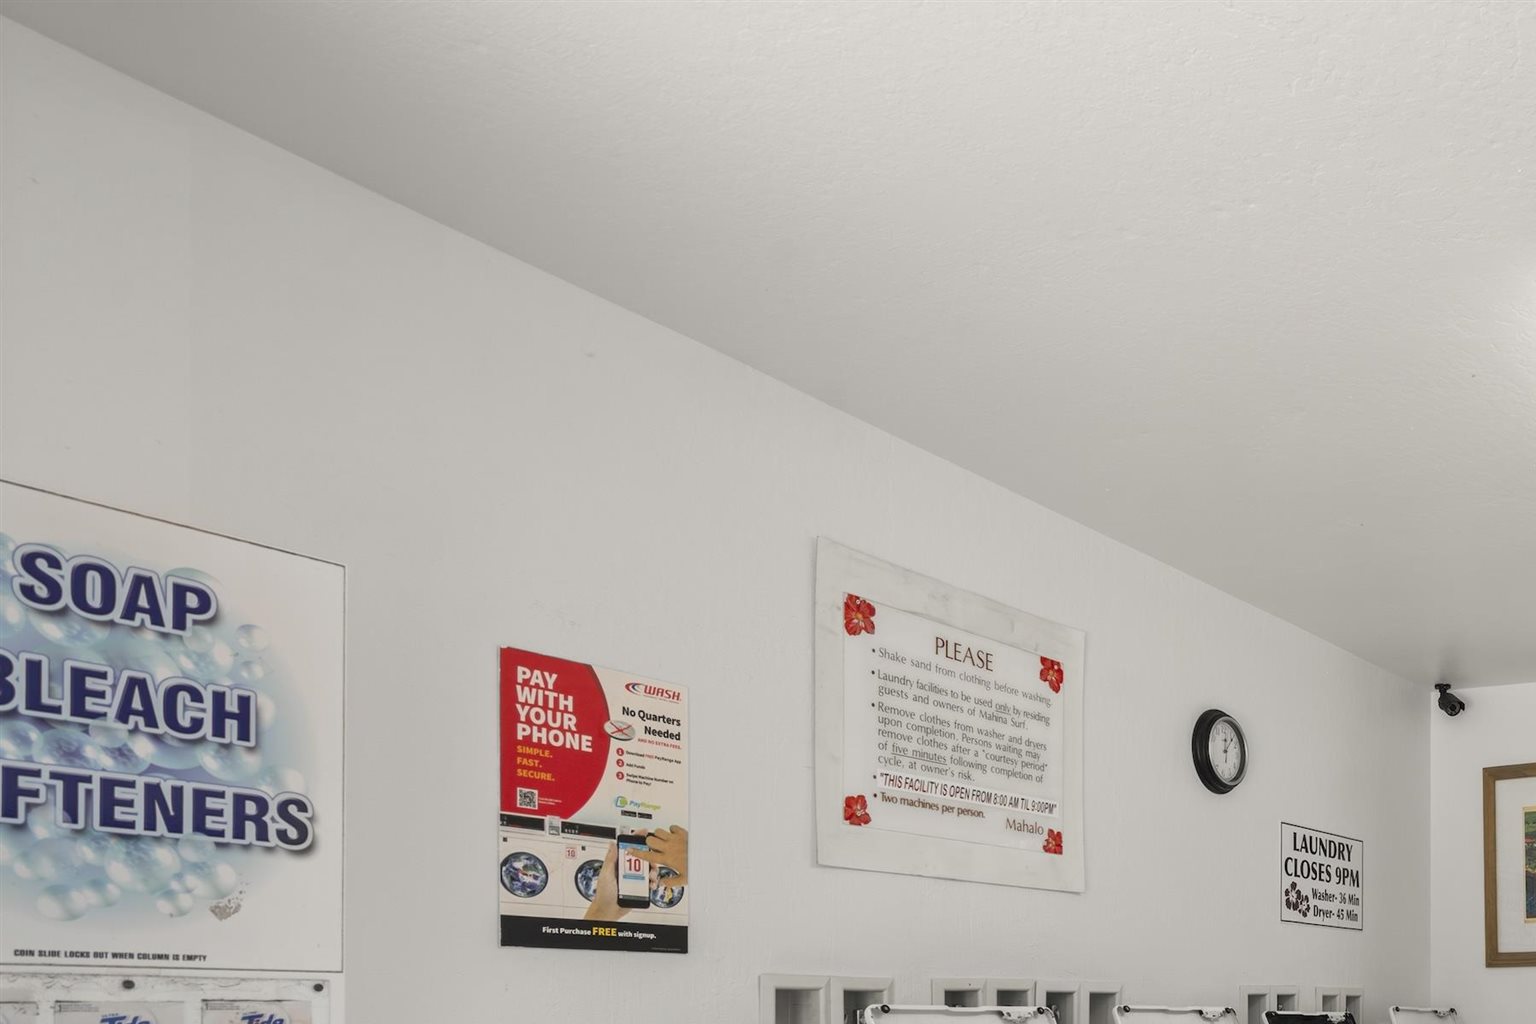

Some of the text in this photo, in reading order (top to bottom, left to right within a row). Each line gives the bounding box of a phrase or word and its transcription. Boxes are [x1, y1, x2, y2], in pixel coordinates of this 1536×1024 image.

[18, 548, 214, 633] SOAP
[936, 637, 993, 672] PLEASE
[517, 666, 558, 689] PAY
[879, 647, 906, 664] Shake
[911, 659, 931, 671] sand
[936, 664, 956, 678] from
[959, 672, 991, 691] clothing
[994, 681, 1019, 696] before
[516, 685, 574, 712] WITH
[644, 685, 681, 701] WASH
[878, 669, 1050, 727] Laundry facilities to be used only by residing
[515, 703, 577, 731] YOUR
[622, 706, 681, 726] No Quarters
[878, 685, 1028, 730] guests and owners of Mahina Surf.
[516, 723, 593, 753] PHONE
[644, 726, 681, 741] Needed
[878, 701, 1047, 751] Remove clothes from washer and dryers
[878, 716, 903, 729] upon
[962, 733, 992, 748] Persons
[995, 743, 1023, 758] waiting
[1025, 751, 1040, 761] may
[516, 745, 553, 758] SIMPLE.
[878, 729, 913, 743] remove
[917, 736, 948, 751] clothes
[951, 743, 970, 756] after
[516, 757, 542, 768] FAST.
[516, 768, 555, 781] SECURE.
[878, 740, 1044, 783] of five minutes following completion of
[908, 761, 917, 770] at
[921, 764, 955, 777] owner's
[958, 770, 975, 781] risk.
[1, 763, 311, 848] FTENERS
[880, 791, 985, 818] Two machines per person.
[904, 777, 939, 795] FACILITY
[940, 783, 948, 797] IS
[949, 785, 970, 800] OPEN
[971, 789, 992, 804] FROM
[993, 793, 1008, 807] 8:00
[1008, 796, 1019, 808] AM
[1021, 797, 1030, 811] TIL
[1006, 818, 1044, 835] Mahalo
[1293, 832, 1353, 862] LAUNDRY
[626, 858, 641, 872] 10
[1284, 857, 1360, 888] CLOSES 9PM
[1338, 892, 1346, 905] 36
[1348, 893, 1360, 906] Min
[1336, 909, 1344, 921] 45
[1346, 909, 1358, 922] Min
[542, 926, 657, 940] First Purchase FREE with signup.
[14, 948, 207, 962] COIN SLIDE LOCKS OUT WHEN COLUMN IS EMPTY
